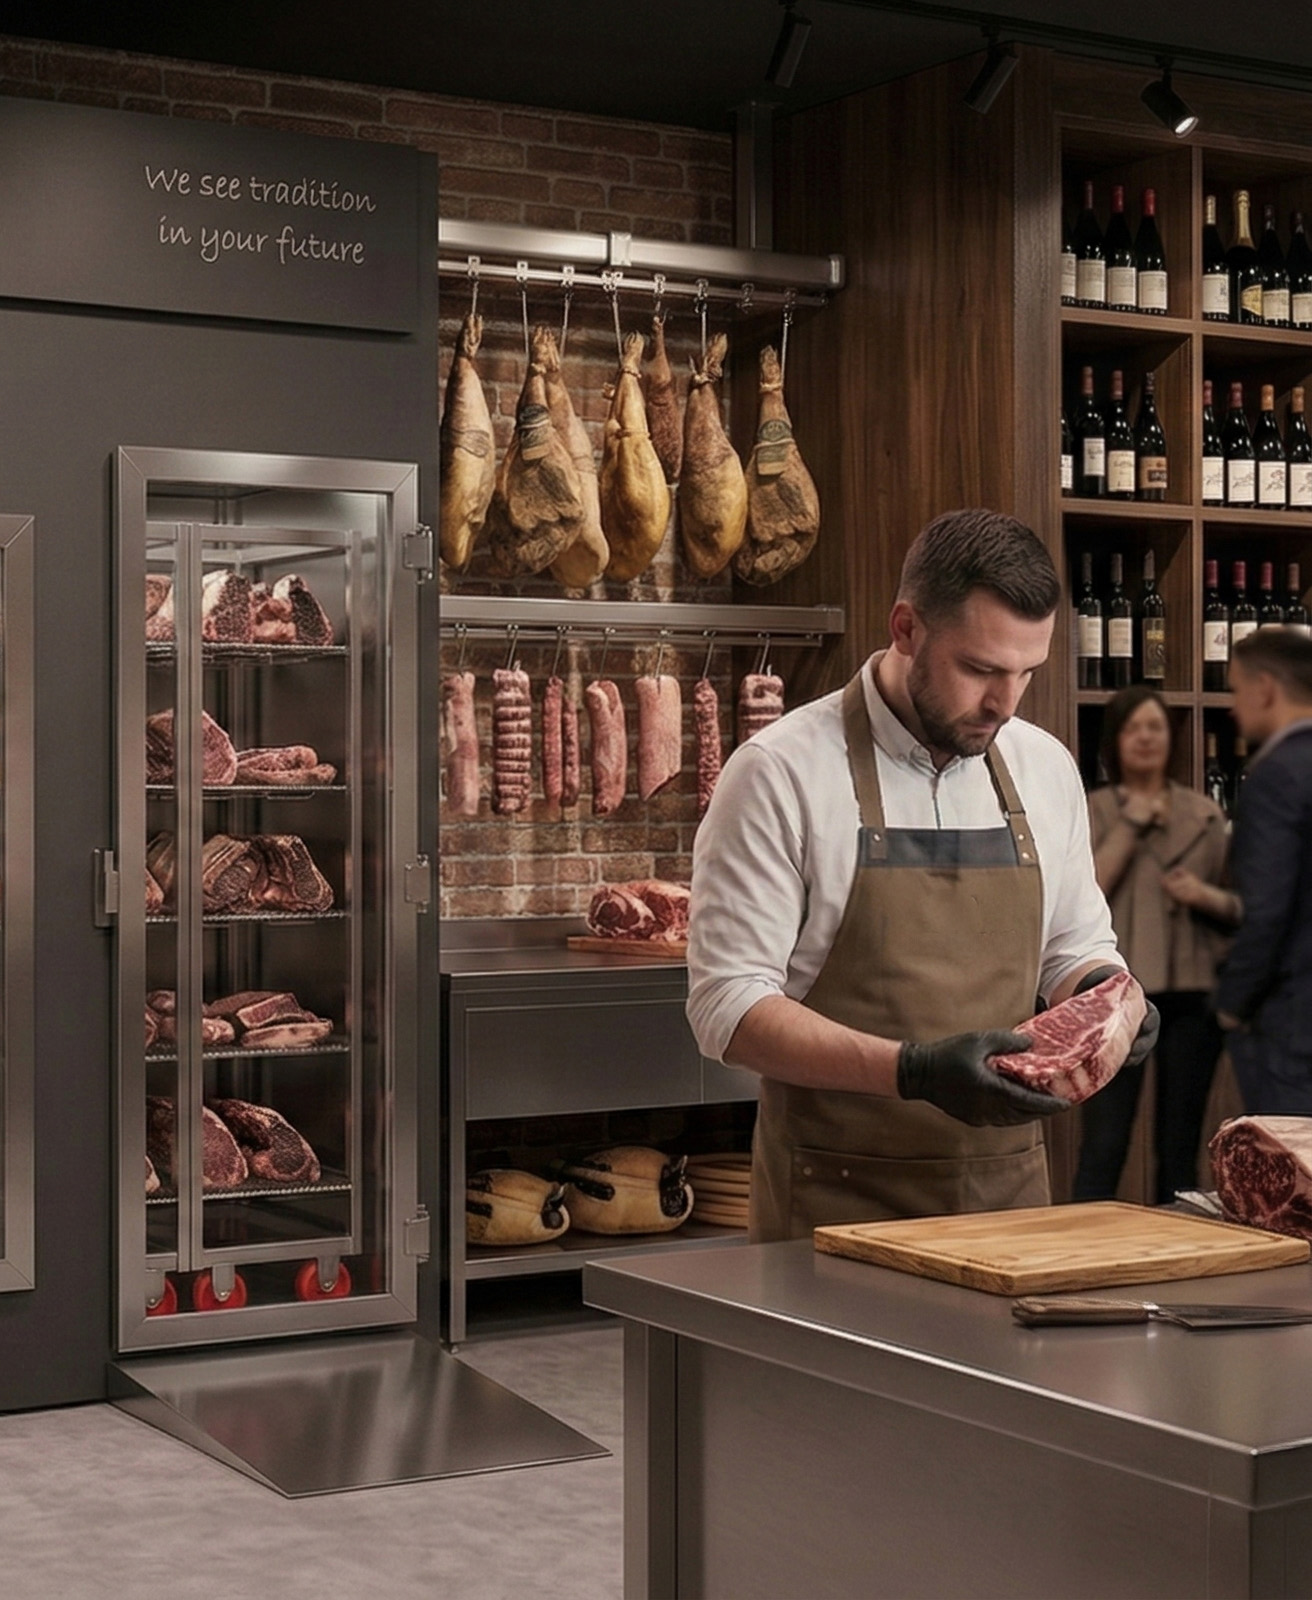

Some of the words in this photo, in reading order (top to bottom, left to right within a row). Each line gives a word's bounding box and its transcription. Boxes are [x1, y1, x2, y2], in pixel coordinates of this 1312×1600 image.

[144, 165, 191, 195] We
[199, 174, 241, 200] see
[249, 176, 377, 213] tradition
[158, 215, 192, 245] in
[200, 226, 269, 263] your
[275, 225, 365, 265] future
